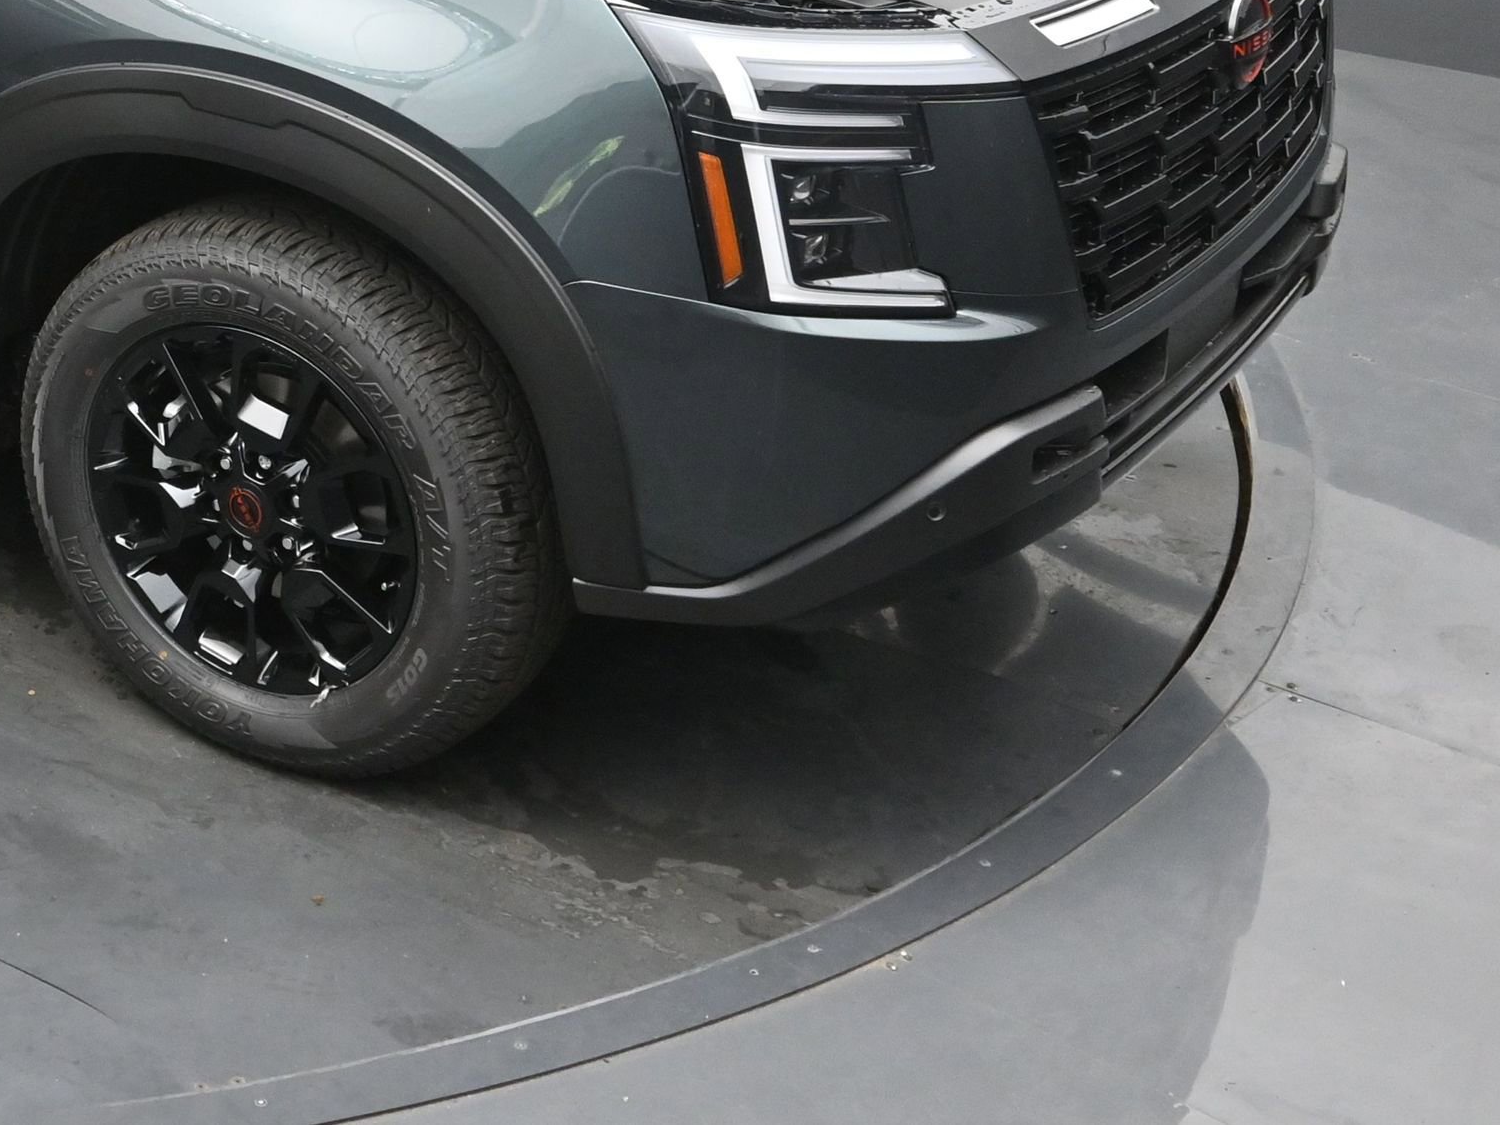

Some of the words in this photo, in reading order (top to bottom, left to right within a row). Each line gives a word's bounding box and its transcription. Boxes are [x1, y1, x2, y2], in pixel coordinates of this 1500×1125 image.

[1232, 30, 1270, 59] NISS
[143, 283, 417, 451] GEOLANDAR
[59, 535, 252, 736] YOKOHAMA
